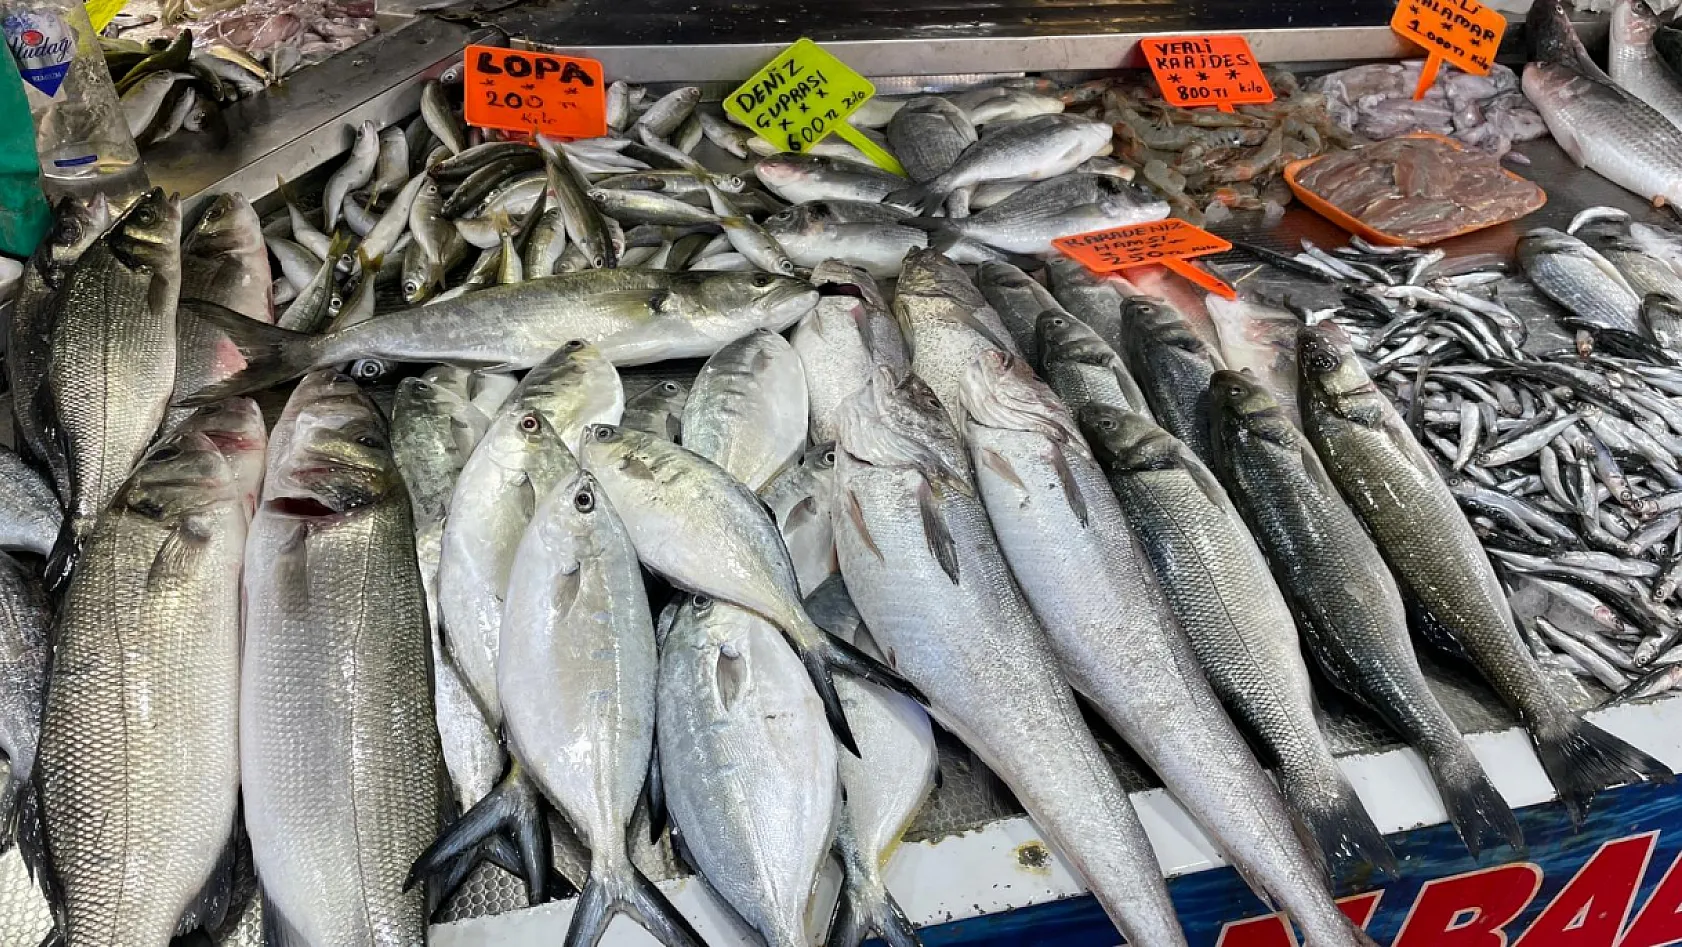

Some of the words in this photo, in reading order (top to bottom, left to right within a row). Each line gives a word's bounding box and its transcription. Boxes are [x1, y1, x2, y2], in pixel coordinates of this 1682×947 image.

[476, 52, 595, 87] LOPA
[486, 91, 543, 109] 200
[1176, 86, 1211, 99] 800
[788, 117, 825, 151] 600
